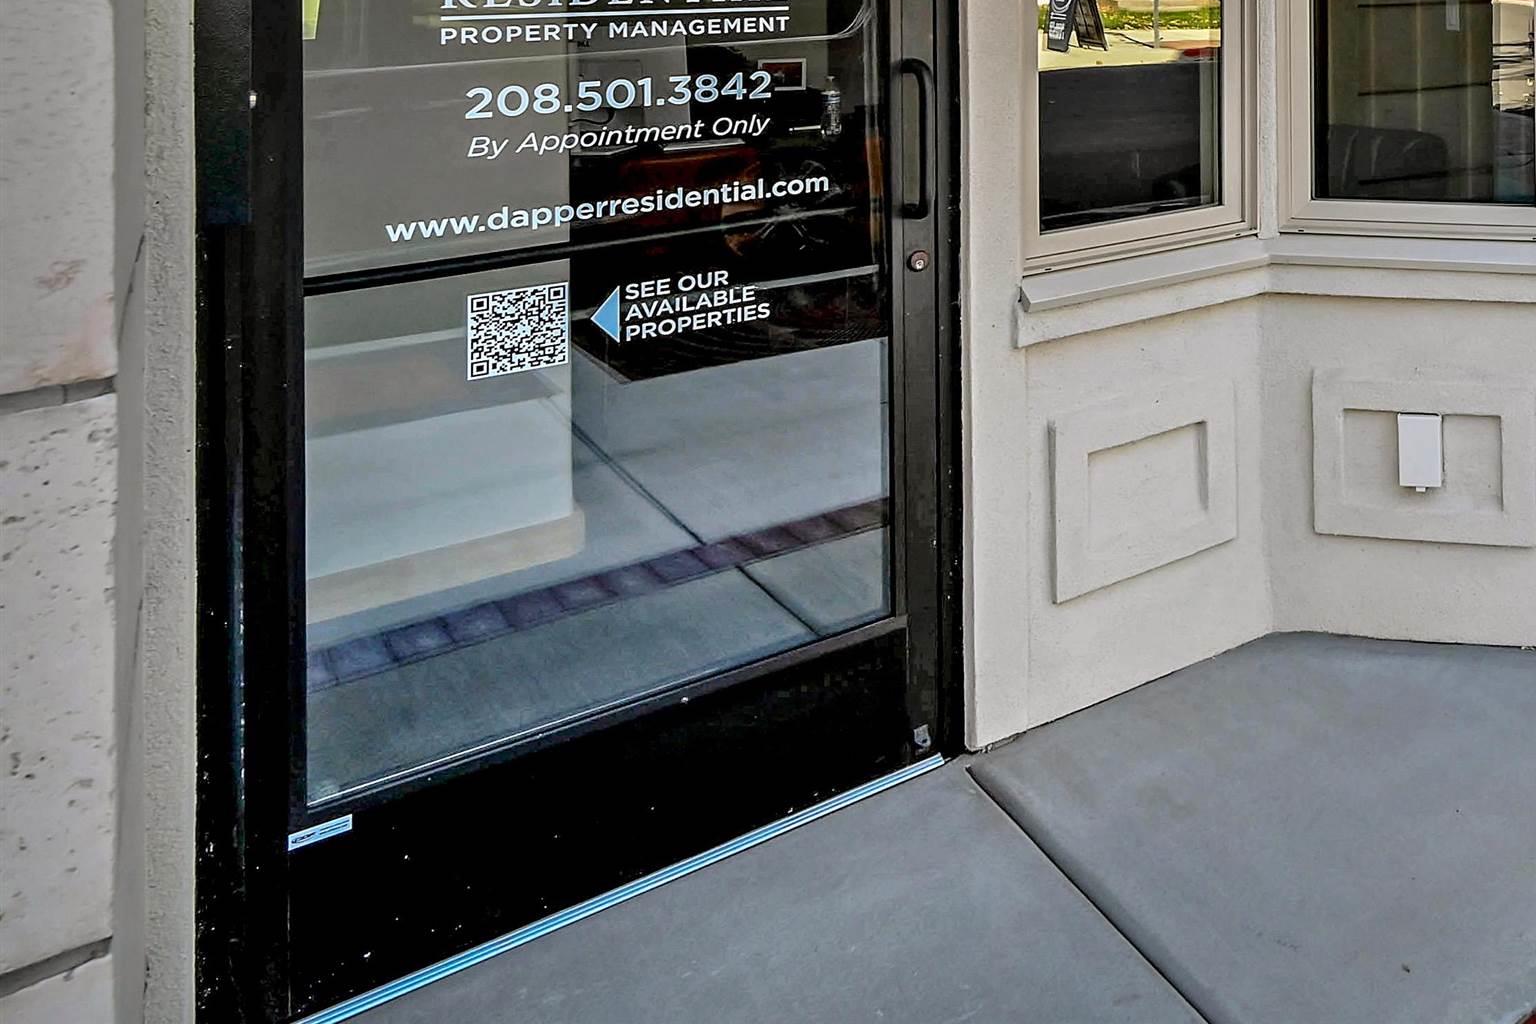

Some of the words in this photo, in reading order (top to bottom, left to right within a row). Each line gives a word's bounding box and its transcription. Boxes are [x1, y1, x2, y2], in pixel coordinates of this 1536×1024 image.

[440, 22, 596, 46] PROPERTY
[608, 15, 790, 40] MANAGEMENT
[465, 71, 772, 119] 208.501.3842
[467, 134, 509, 160] By
[515, 116, 705, 158] Appointment
[712, 112, 771, 140] Only
[385, 175, 829, 242] www.dapperresidential.com
[624, 285, 756, 320] AVAILABLE
[625, 280, 671, 301] SEE
[677, 270, 730, 293] OUR
[625, 302, 772, 343] PROPERTIES
